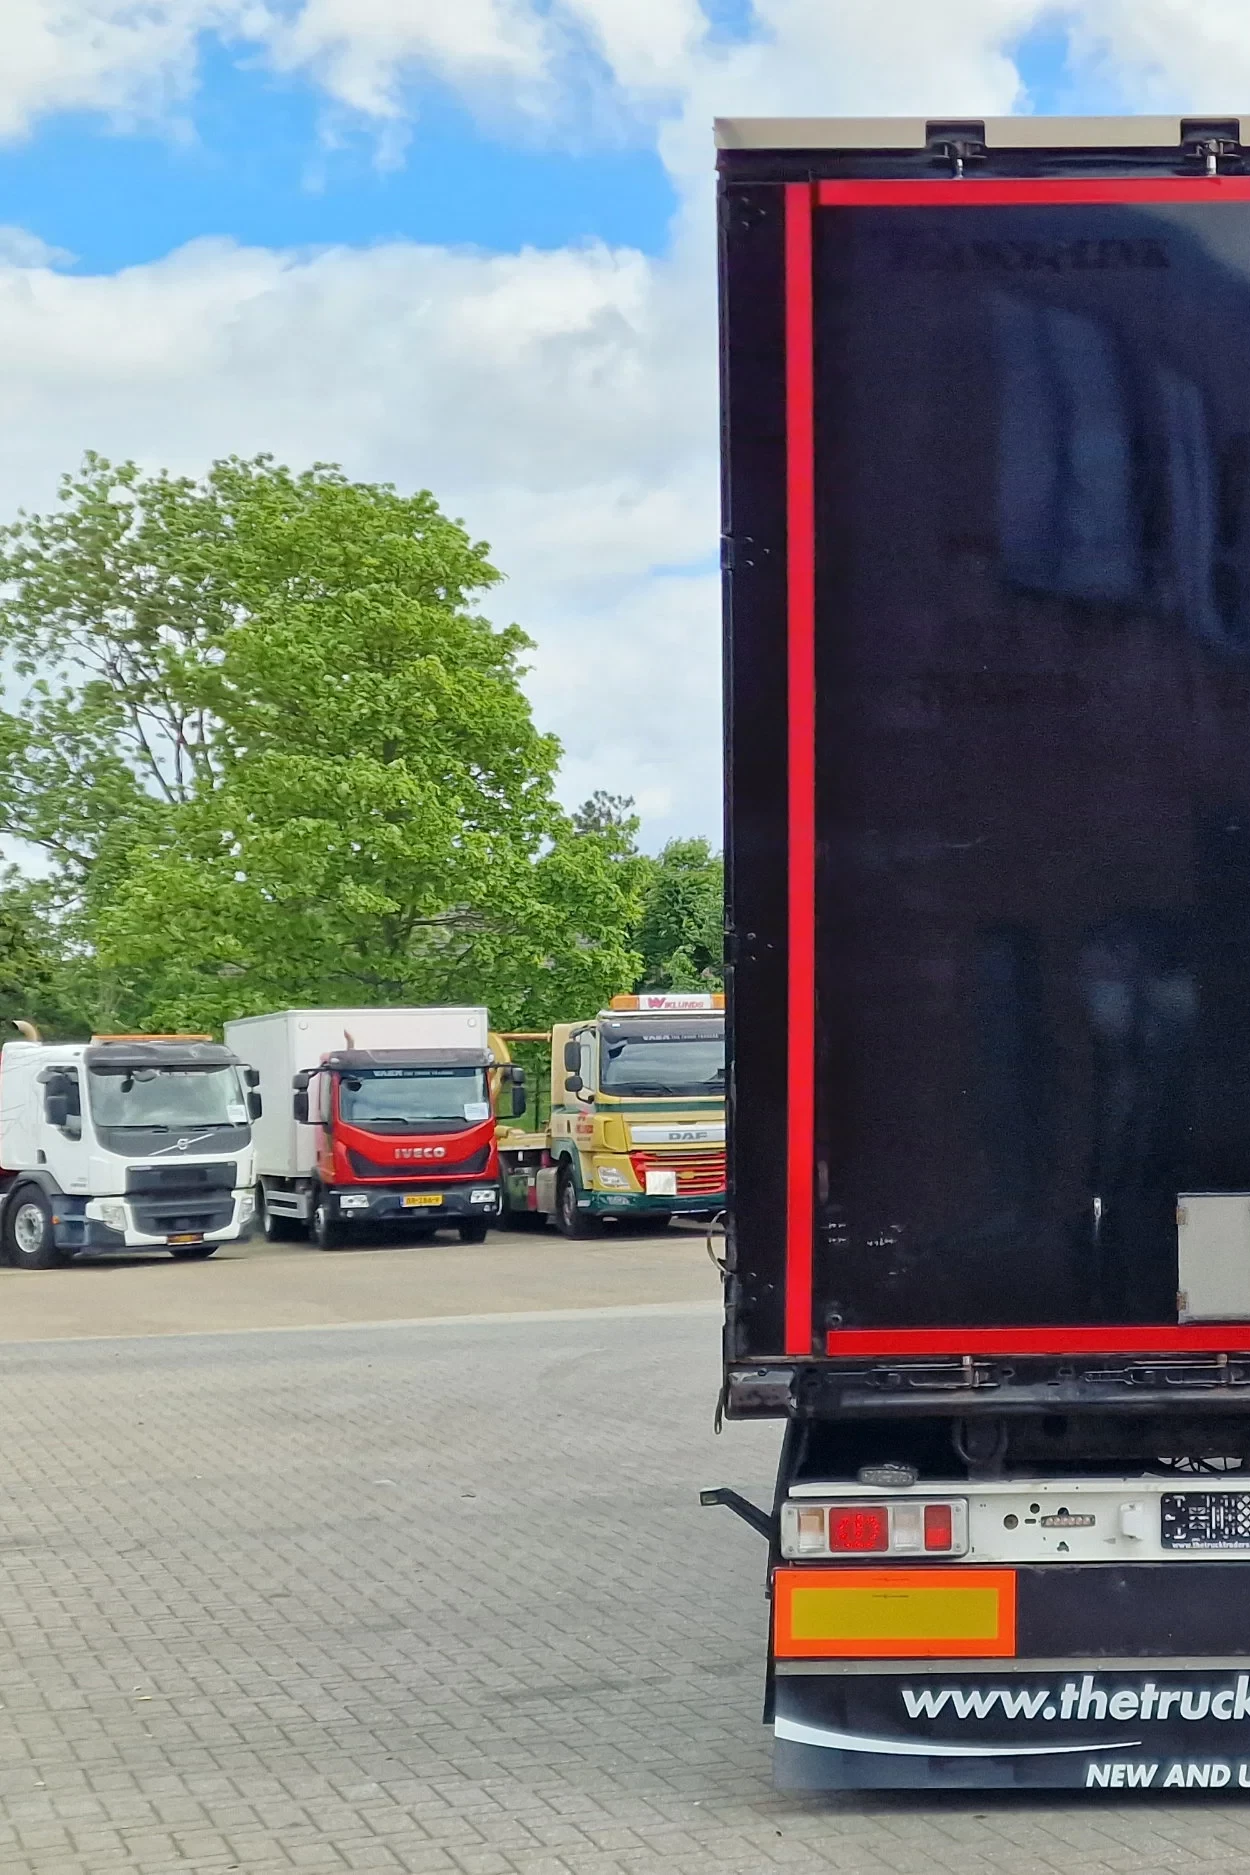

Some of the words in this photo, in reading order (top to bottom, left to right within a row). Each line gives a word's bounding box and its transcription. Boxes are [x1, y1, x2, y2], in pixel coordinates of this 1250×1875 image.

[668, 1132, 708, 1141] DAF
[394, 1146, 446, 1159] IVECO
[1085, 1763, 1158, 1788] NEW
[1163, 1763, 1231, 1788] AND
